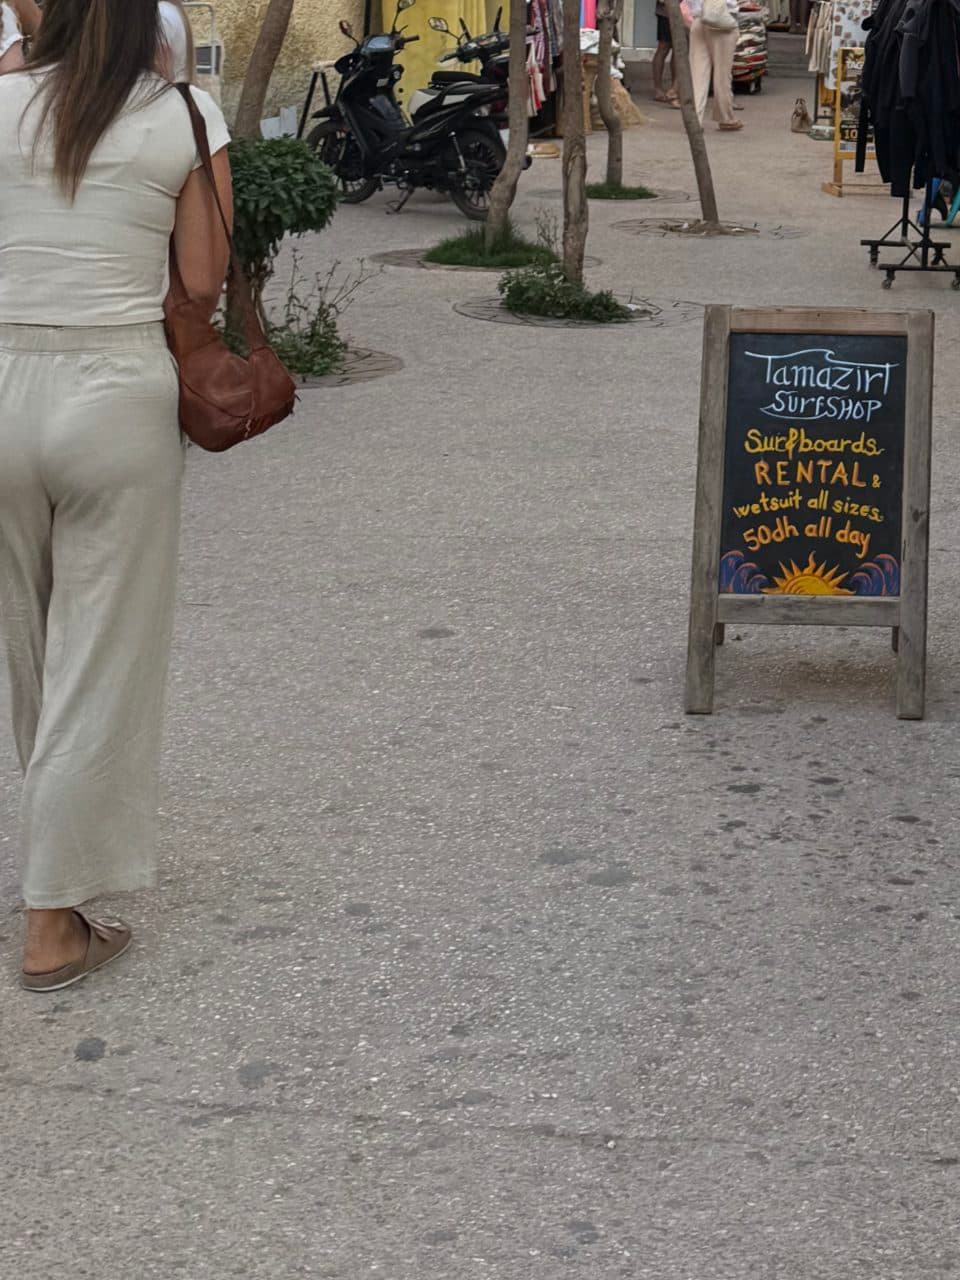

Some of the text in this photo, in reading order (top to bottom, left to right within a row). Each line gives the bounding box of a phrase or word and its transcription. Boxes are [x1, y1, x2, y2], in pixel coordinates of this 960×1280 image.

[754, 459, 882, 488] RENTAL &
[732, 488, 802, 518] wetsuit
[807, 489, 829, 510] all
[742, 515, 872, 559] 50dh all day
